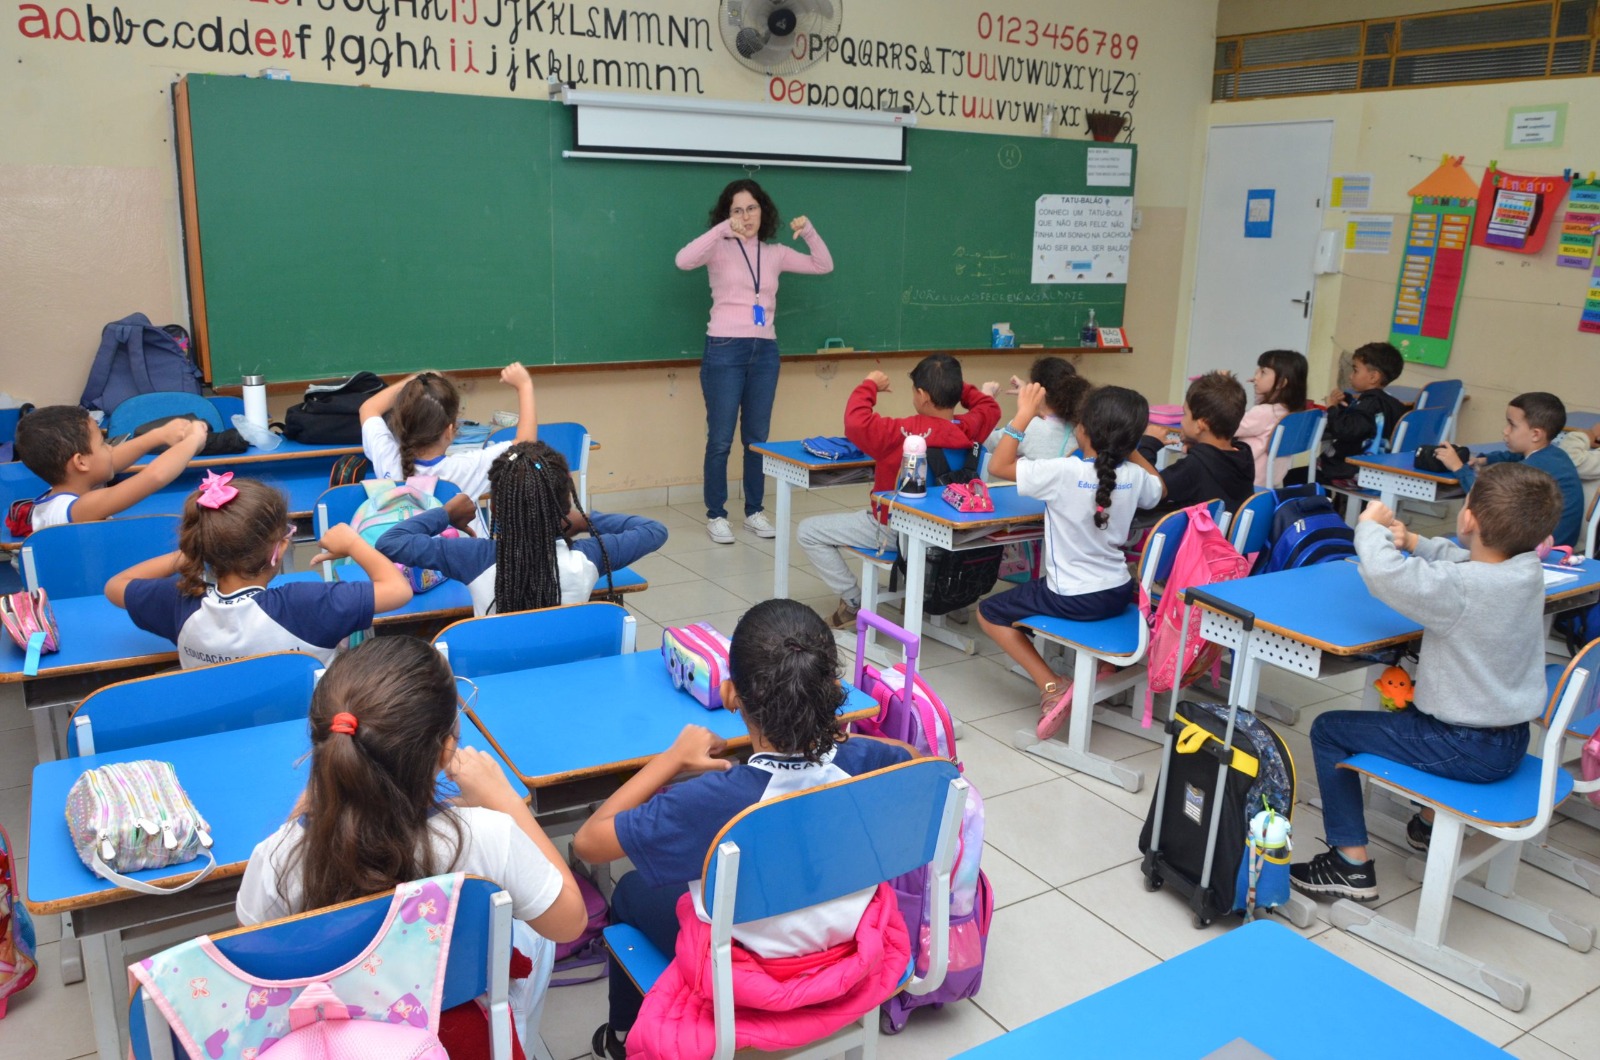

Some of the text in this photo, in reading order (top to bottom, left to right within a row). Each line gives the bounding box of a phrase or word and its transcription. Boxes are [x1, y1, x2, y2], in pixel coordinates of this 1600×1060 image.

[1061, 197, 1103, 205] TATU-BALÃO
[1038, 208, 1123, 217] CONHECI UM TATU-BOLA
[1038, 220, 1052, 229] QUE
[1056, 218, 1071, 228] NÃO
[1074, 220, 1088, 228] ERA
[1111, 219, 1125, 229] NÃO
[1035, 231, 1054, 239] TINHA
[1056, 231, 1067, 239] UM
[1068, 231, 1091, 239] SONHO
[1091, 231, 1101, 239] NA
[1037, 243, 1052, 252] NÃO
[1055, 243, 1068, 252] SER
[1092, 243, 1105, 252] SER
[1101, 329, 1119, 337] NÃO
[1104, 337, 1122, 345] SAIR
